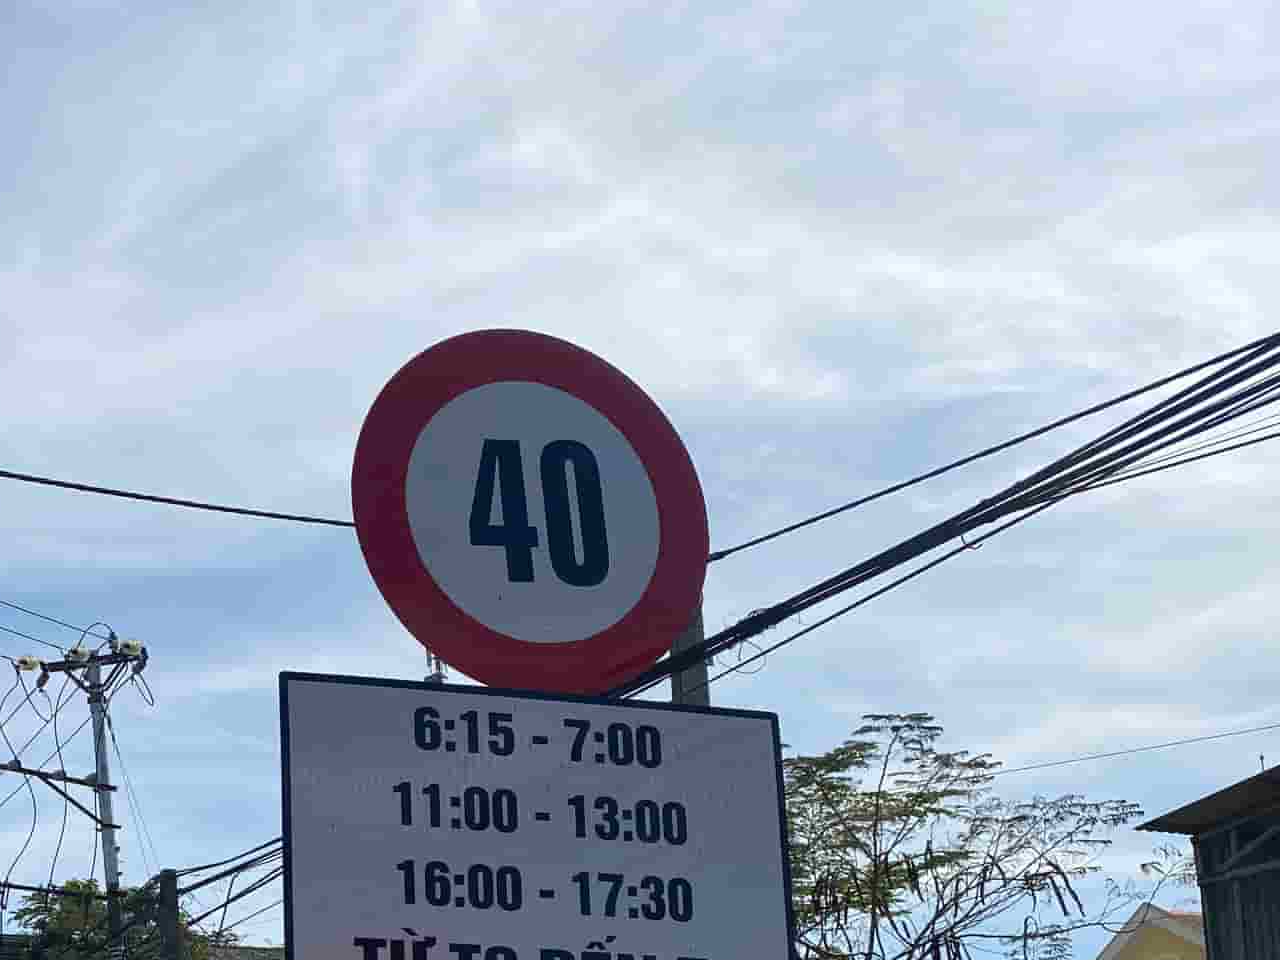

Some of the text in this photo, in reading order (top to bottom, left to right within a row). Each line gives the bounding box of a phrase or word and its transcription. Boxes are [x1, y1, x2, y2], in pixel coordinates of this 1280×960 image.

[468, 437, 611, 588] 40
[413, 705, 516, 758] 6:15
[563, 717, 663, 769] 7:00
[392, 781, 519, 834] 11:00
[568, 794, 688, 846] 13:00
[395, 859, 523, 912] 16:00
[570, 871, 694, 923] 17:30
